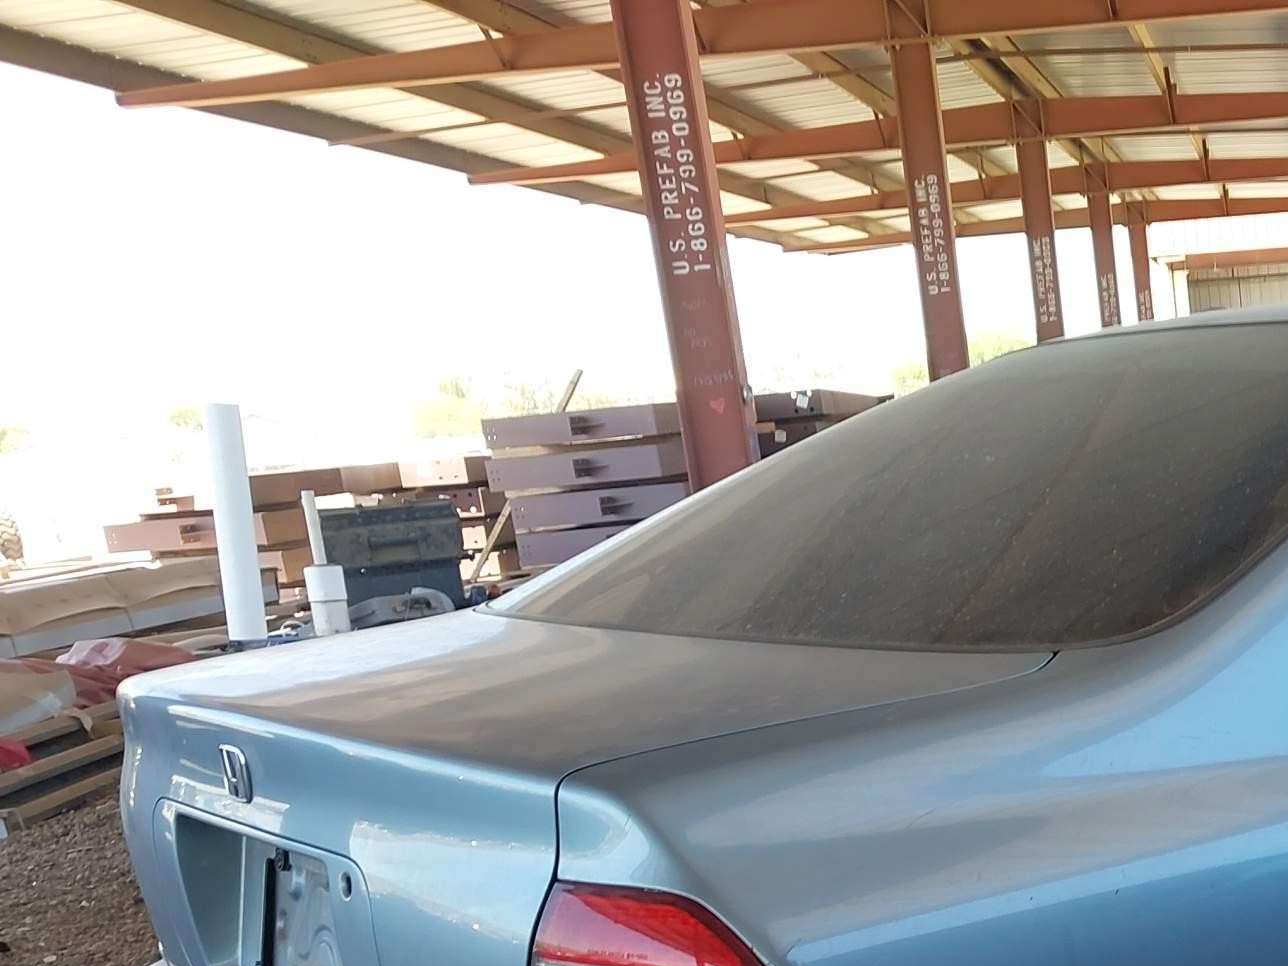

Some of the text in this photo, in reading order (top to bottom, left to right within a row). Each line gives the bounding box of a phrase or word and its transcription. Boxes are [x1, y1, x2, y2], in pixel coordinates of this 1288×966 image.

[643, 72, 690, 275] U.S. PREFAB INC.
[663, 72, 712, 272] 1-866-799-0969
[919, 207, 935, 262] PREFAB
